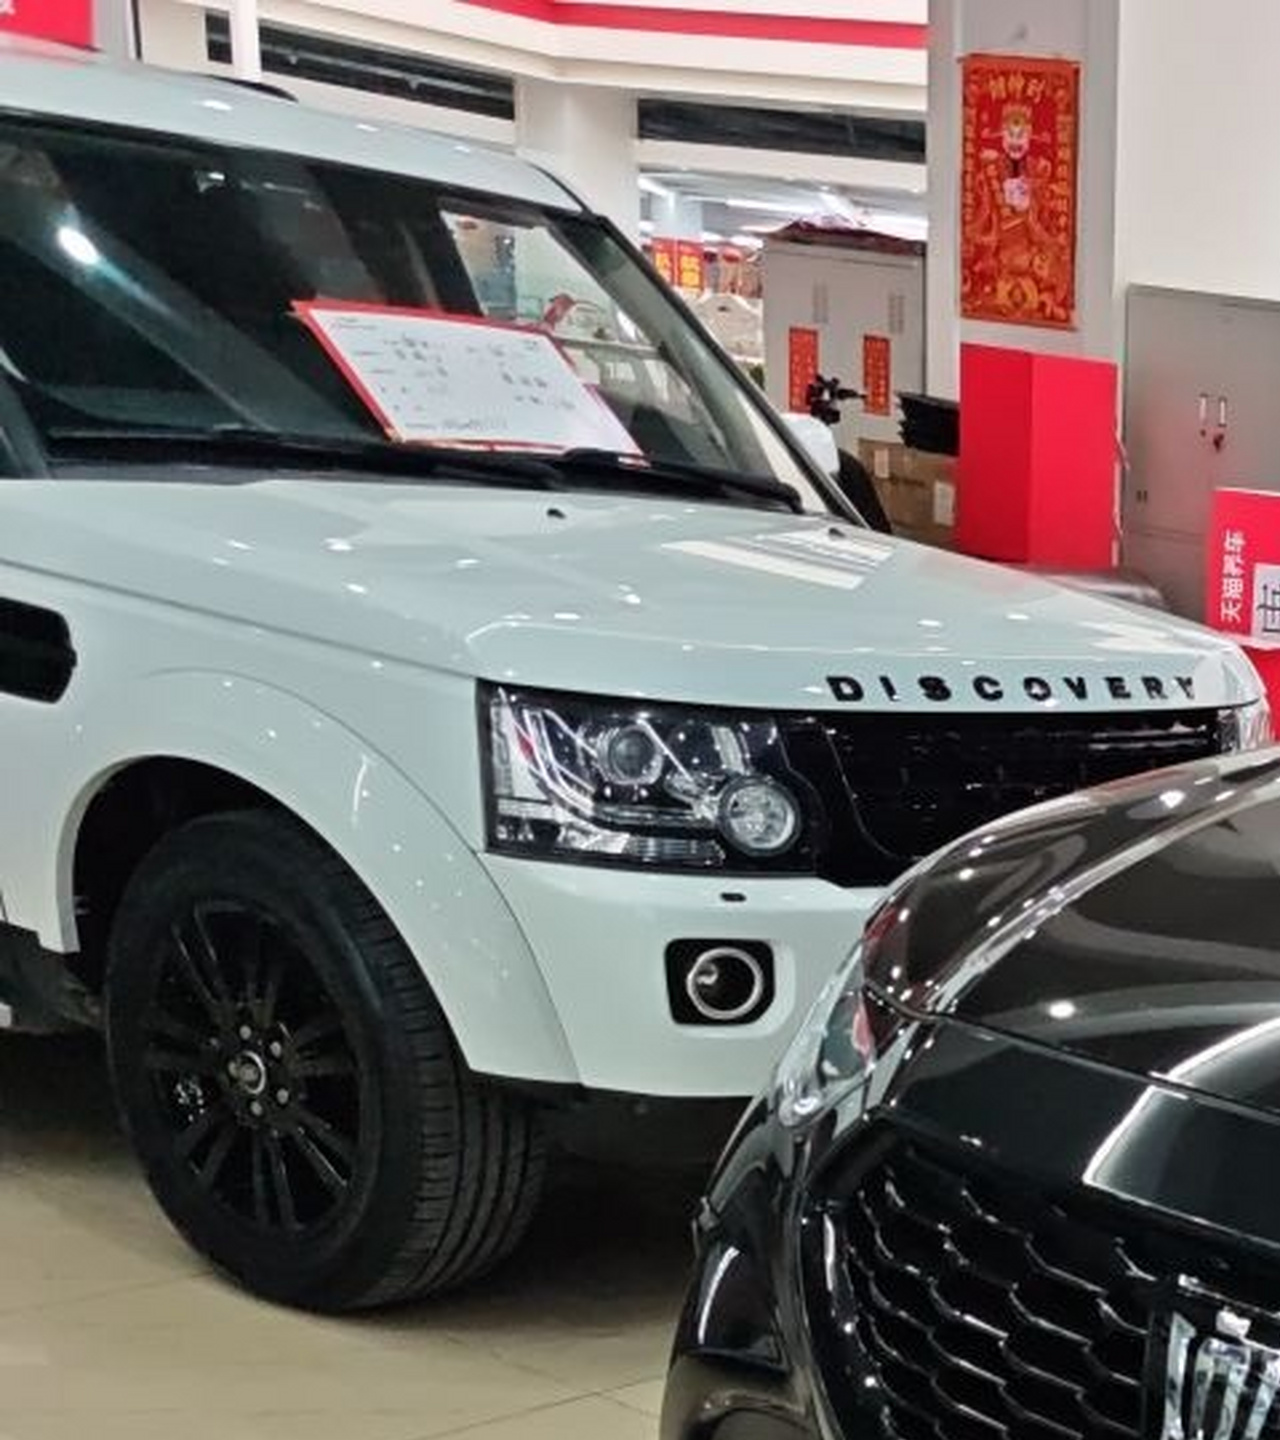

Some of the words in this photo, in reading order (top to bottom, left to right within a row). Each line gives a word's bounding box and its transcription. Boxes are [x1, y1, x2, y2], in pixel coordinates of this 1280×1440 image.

[1220, 529, 1245, 624] 天猫养车
[826, 675, 1197, 702] DISCOVERY
